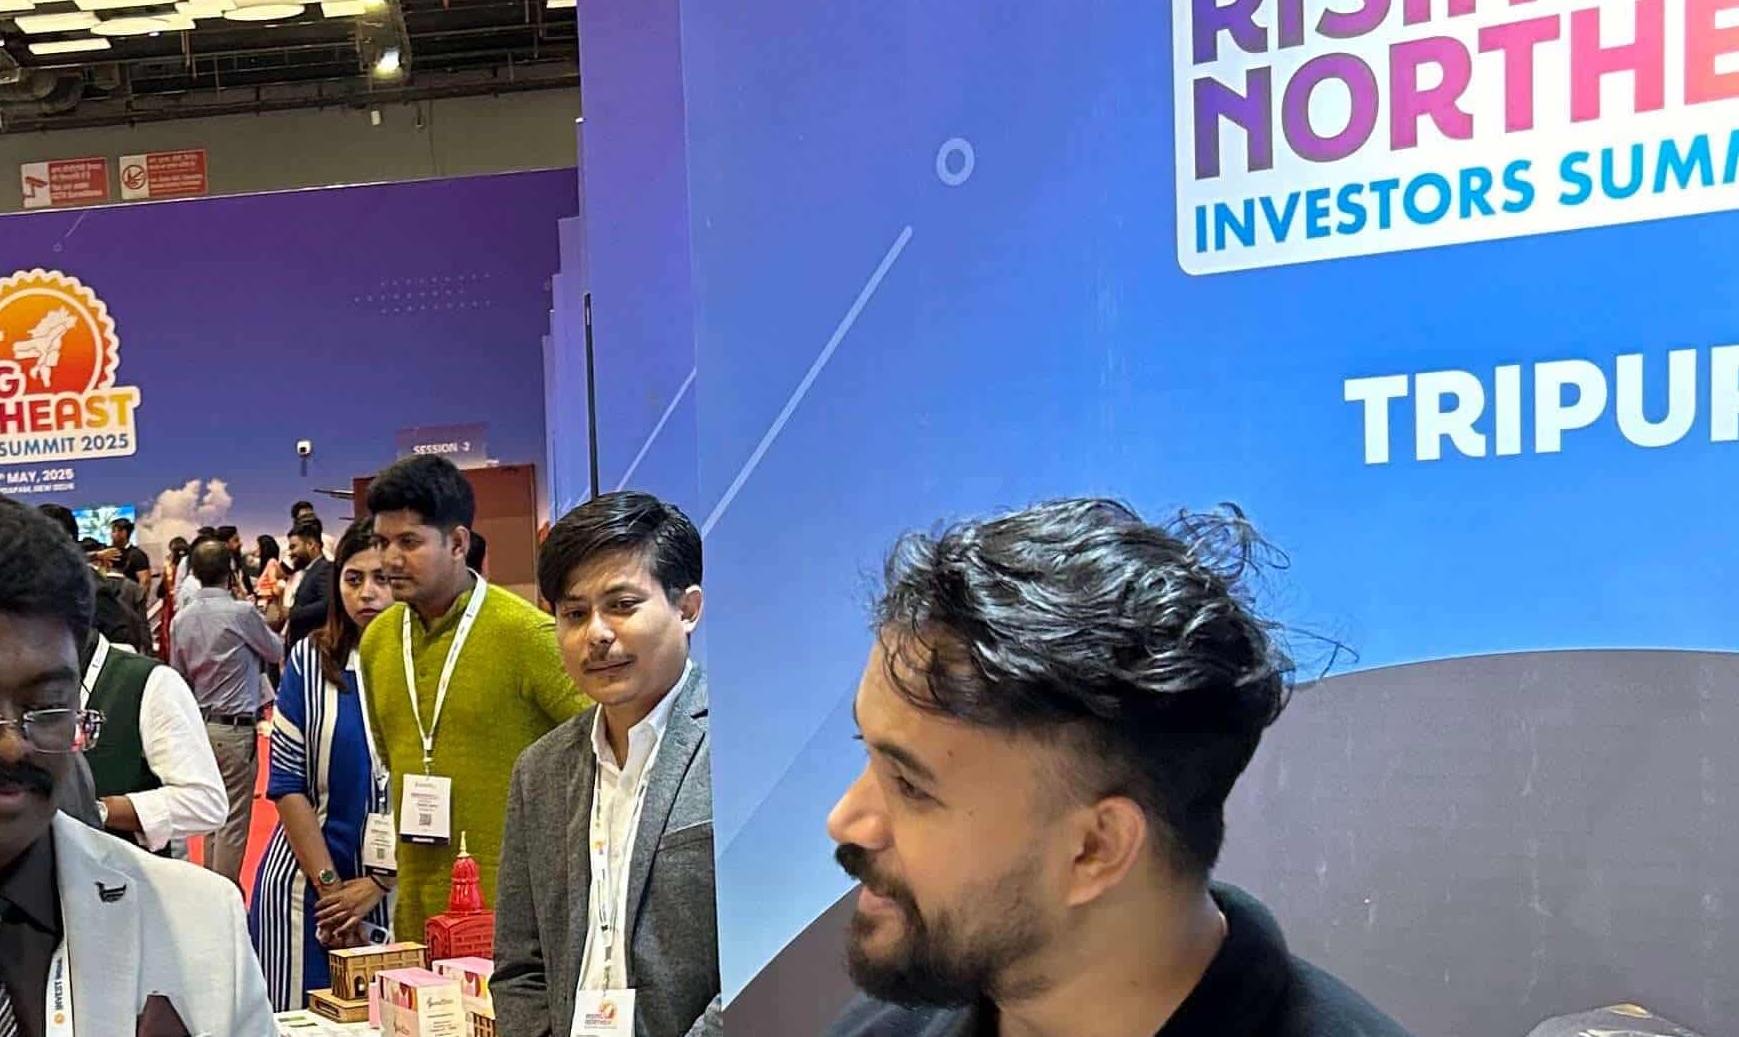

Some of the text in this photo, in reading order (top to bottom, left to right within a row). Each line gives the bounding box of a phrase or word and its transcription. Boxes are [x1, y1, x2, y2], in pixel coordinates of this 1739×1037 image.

[1195, 159, 1535, 254] INVESTORS
[81, 433, 130, 452] 2025
[412, 442, 458, 454] SESSION
[7, 471, 41, 484] MAY,
[42, 468, 75, 481] 2025
